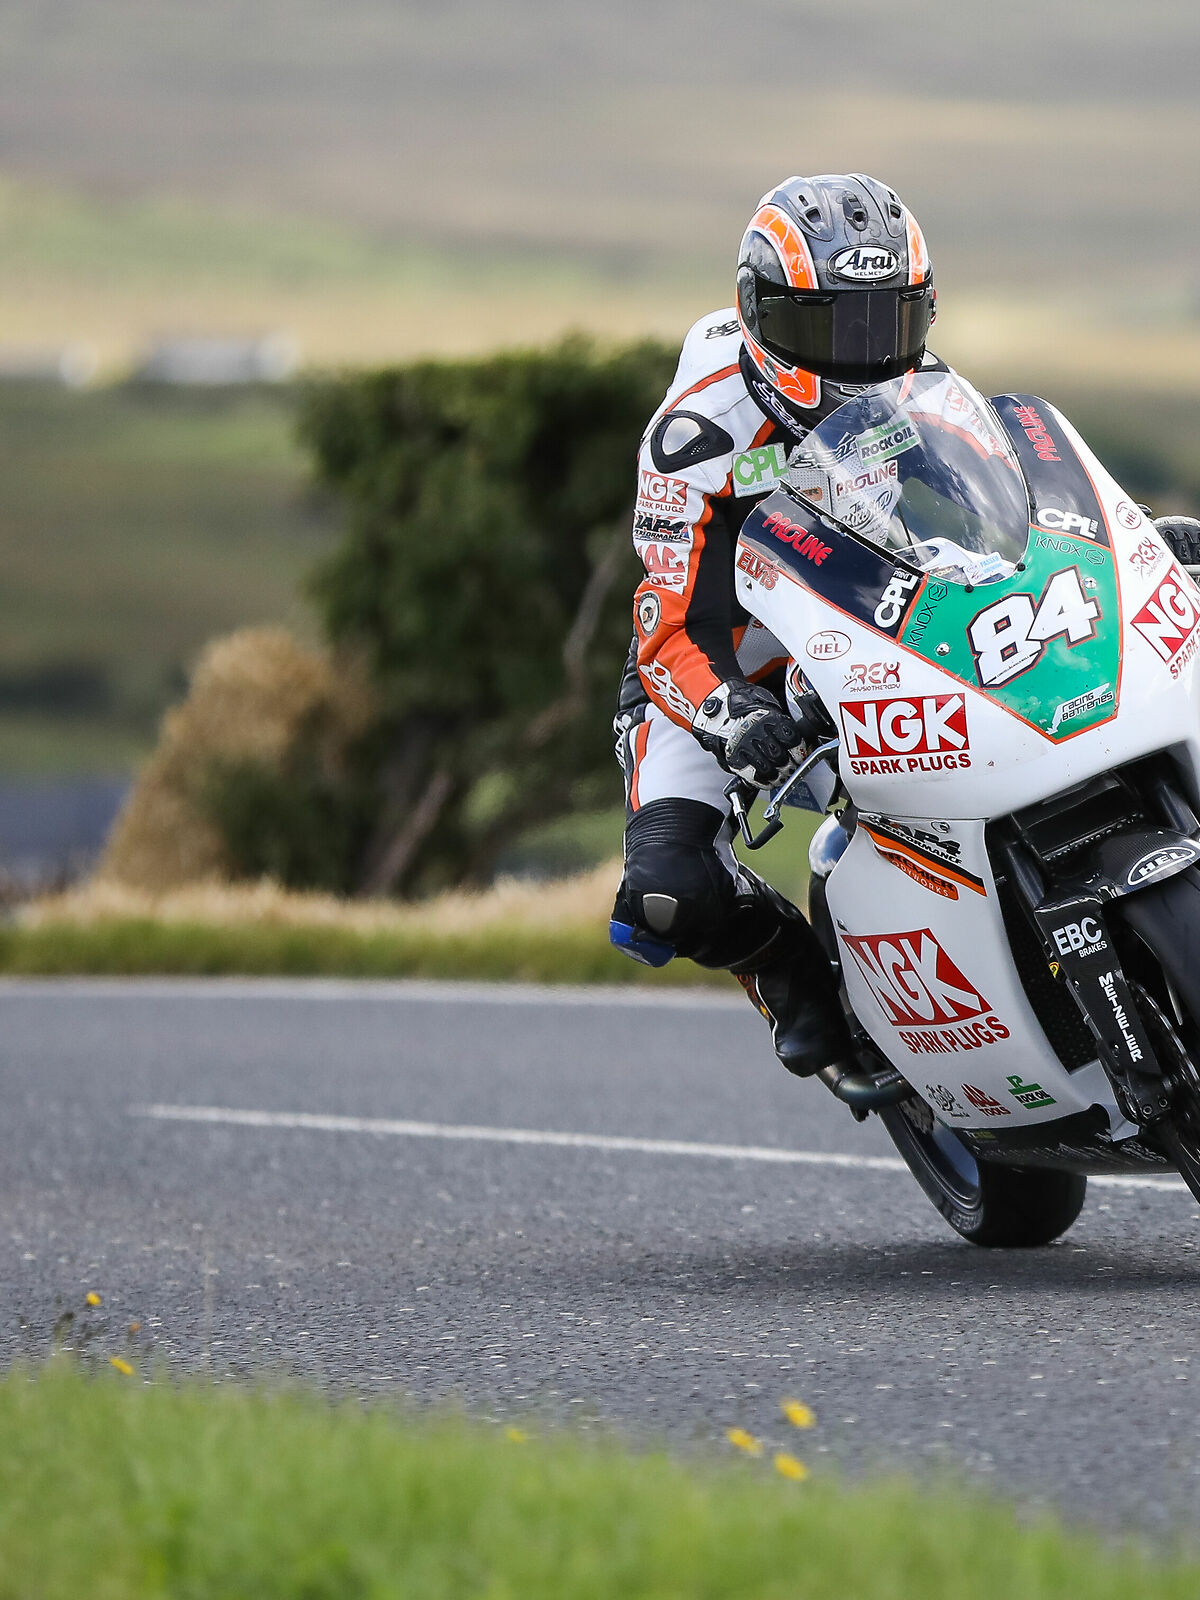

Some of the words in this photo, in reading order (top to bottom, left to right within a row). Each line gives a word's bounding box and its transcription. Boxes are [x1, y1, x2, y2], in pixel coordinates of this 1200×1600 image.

[835, 249, 894, 272] Arai
[861, 436, 894, 459] ROCK
[893, 427, 916, 444] OIL
[1013, 405, 1062, 463] PROLINE
[733, 445, 789, 486] CPL
[836, 461, 897, 497] PROLINE
[639, 472, 688, 506] NGK
[655, 503, 685, 514] PLUGS
[1036, 507, 1097, 540] CPL
[761, 511, 833, 567] PROLINE
[1035, 535, 1084, 557] KNOX
[736, 549, 780, 592] ELVIS
[874, 574, 920, 628] CPL
[907, 602, 938, 648] KNOX
[965, 564, 1103, 690] 84
[813, 643, 842, 655] HEL
[849, 661, 901, 684] REX
[841, 693, 968, 756] NGK
[851, 757, 905, 776] SPARK
[907, 752, 972, 773] PLUGS
[1138, 851, 1186, 877] HEL
[1052, 916, 1103, 957] EBC
[1078, 940, 1108, 959] BRAKES
[844, 931, 983, 1024] NGK
[899, 1030, 947, 1056] SPARK
[942, 1015, 1012, 1053] PLUGS
[979, 1106, 1012, 1117] TOOLS
[1014, 1091, 1038, 1104] ROCK
